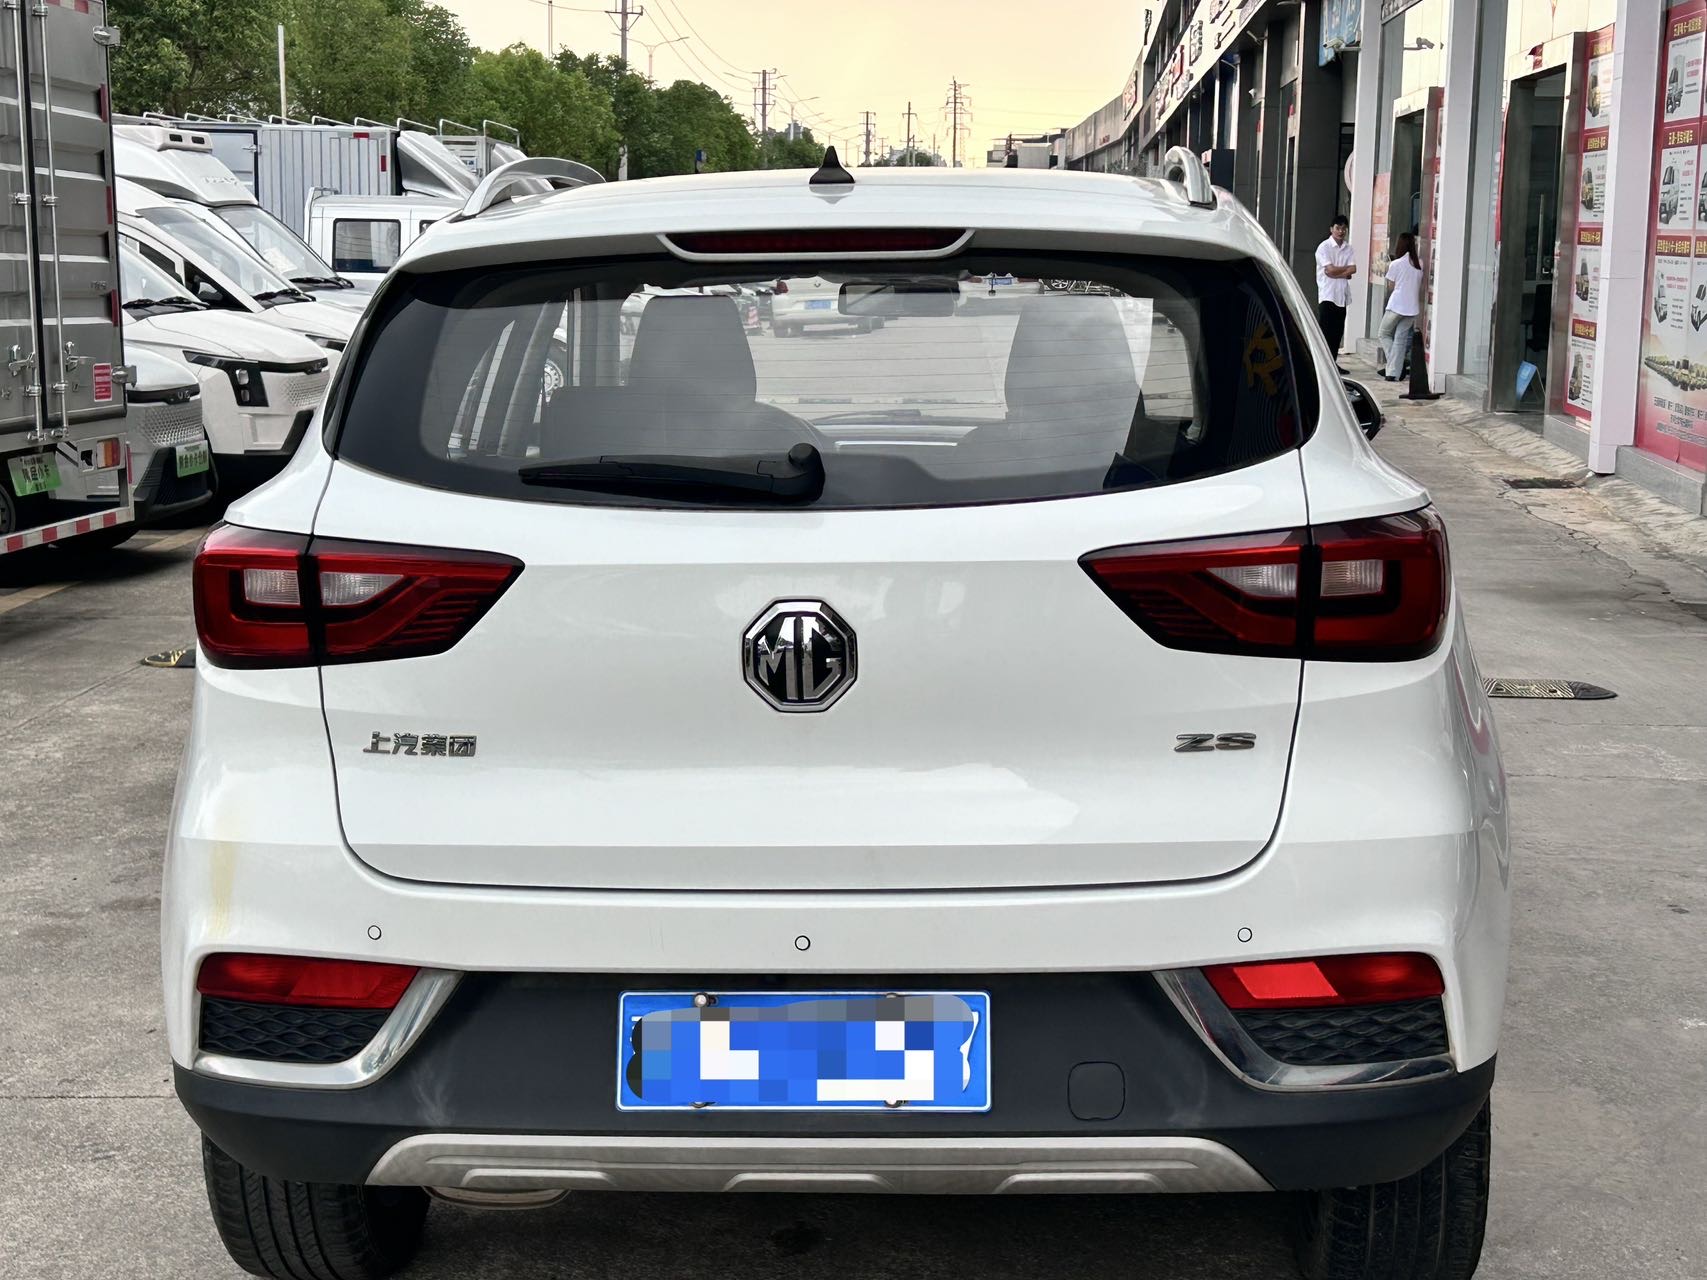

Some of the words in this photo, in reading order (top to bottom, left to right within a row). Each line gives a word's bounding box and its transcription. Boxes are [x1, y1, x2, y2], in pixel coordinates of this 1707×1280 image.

[756, 613, 844, 701] MG
[362, 731, 477, 757] 上汽集团
[1174, 732, 1257, 753] ZS
